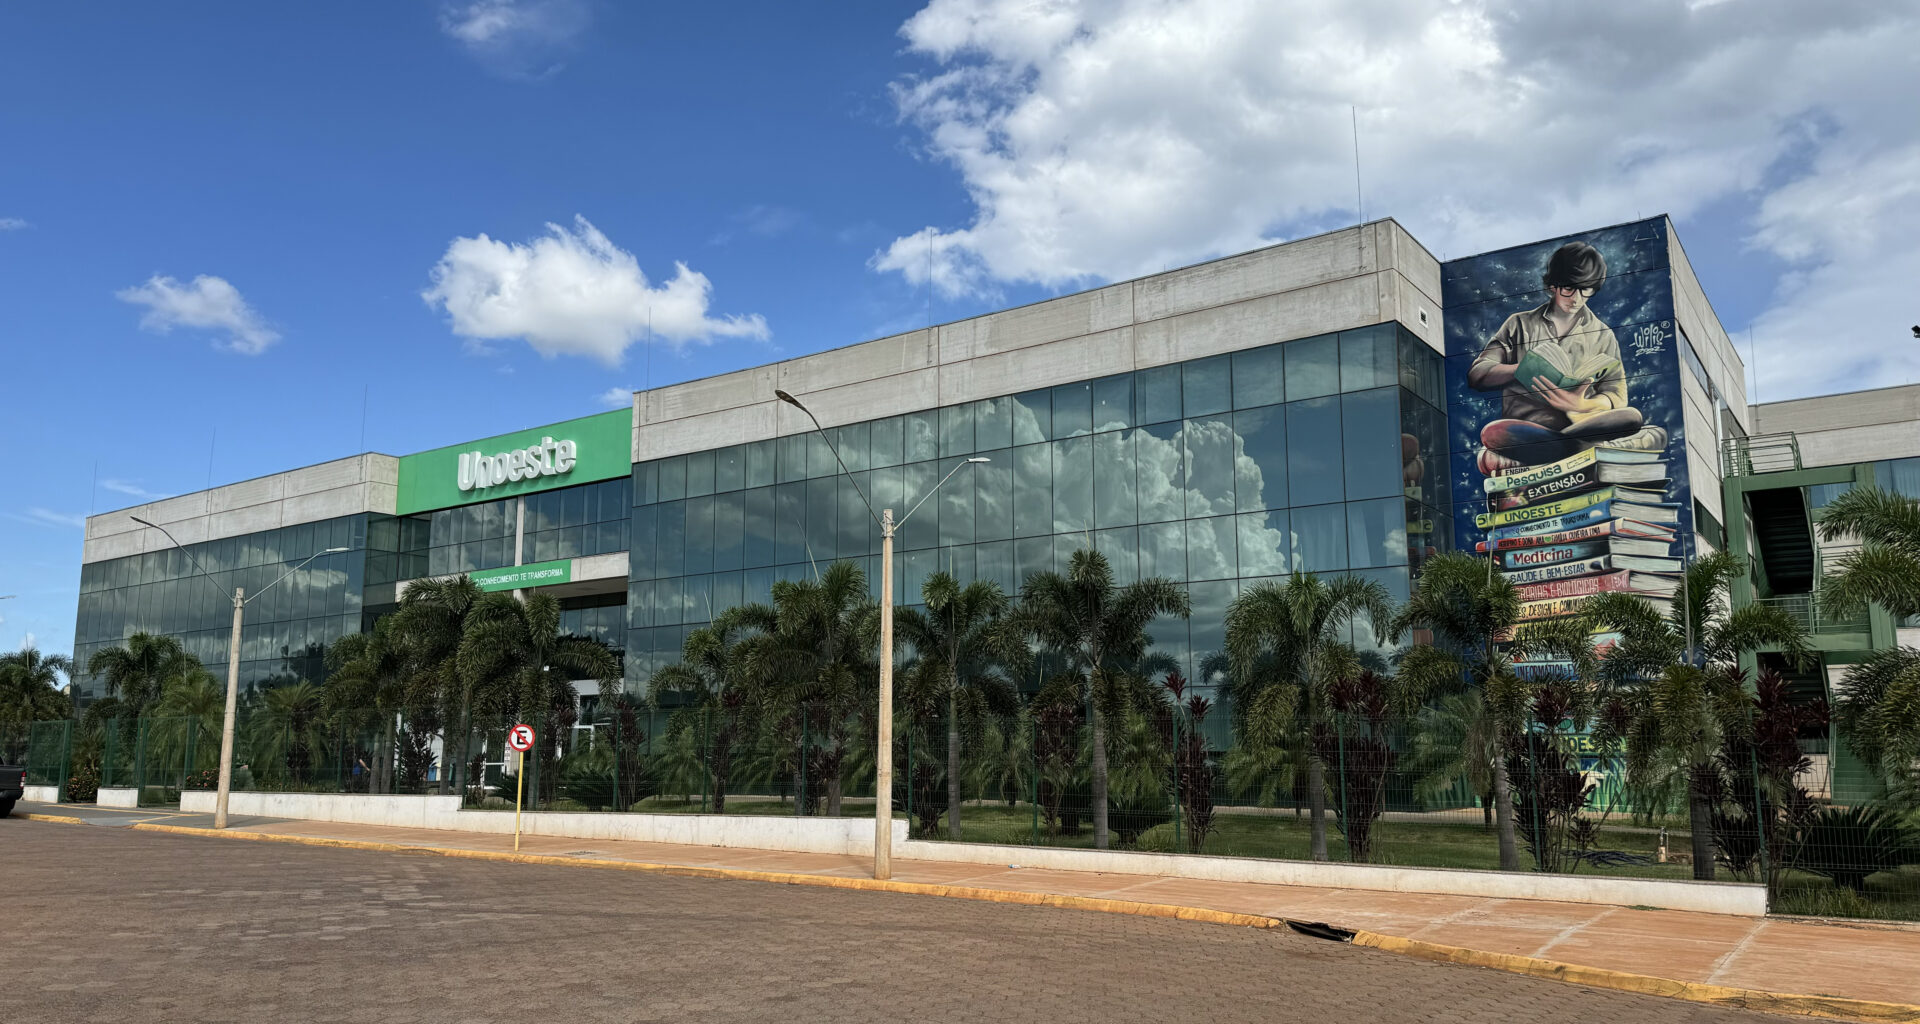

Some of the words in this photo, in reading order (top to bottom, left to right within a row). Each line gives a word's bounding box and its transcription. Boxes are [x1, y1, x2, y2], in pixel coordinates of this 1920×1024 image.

[457, 436, 577, 491] Unoeste
[1506, 464, 1563, 488] Pesquisa
[1527, 472, 1586, 499] EXTENSÃO
[1504, 503, 1563, 523] UNOESTE
[1520, 520, 1551, 534] CONHECIMENTO
[1551, 519, 1559, 527] TE
[1559, 512, 1590, 526] TRANSFORMA
[1522, 537, 1534, 545] DONA
[1552, 532, 1567, 541] FAMÍLIA
[1568, 528, 1588, 540] OLIVEIRA
[1589, 526, 1601, 536] LIMA
[1512, 548, 1573, 566] Medicina
[480, 574, 519, 586] CONHECIMENTO
[520, 572, 527, 581] TE
[527, 568, 563, 580] TRANSFORMA
[1510, 569, 1537, 585] SAÚDE
[1539, 570, 1544, 580] E
[1528, 602, 1553, 616] DESIGN
[1552, 601, 1558, 615] E
[516, 730, 528, 745] E
